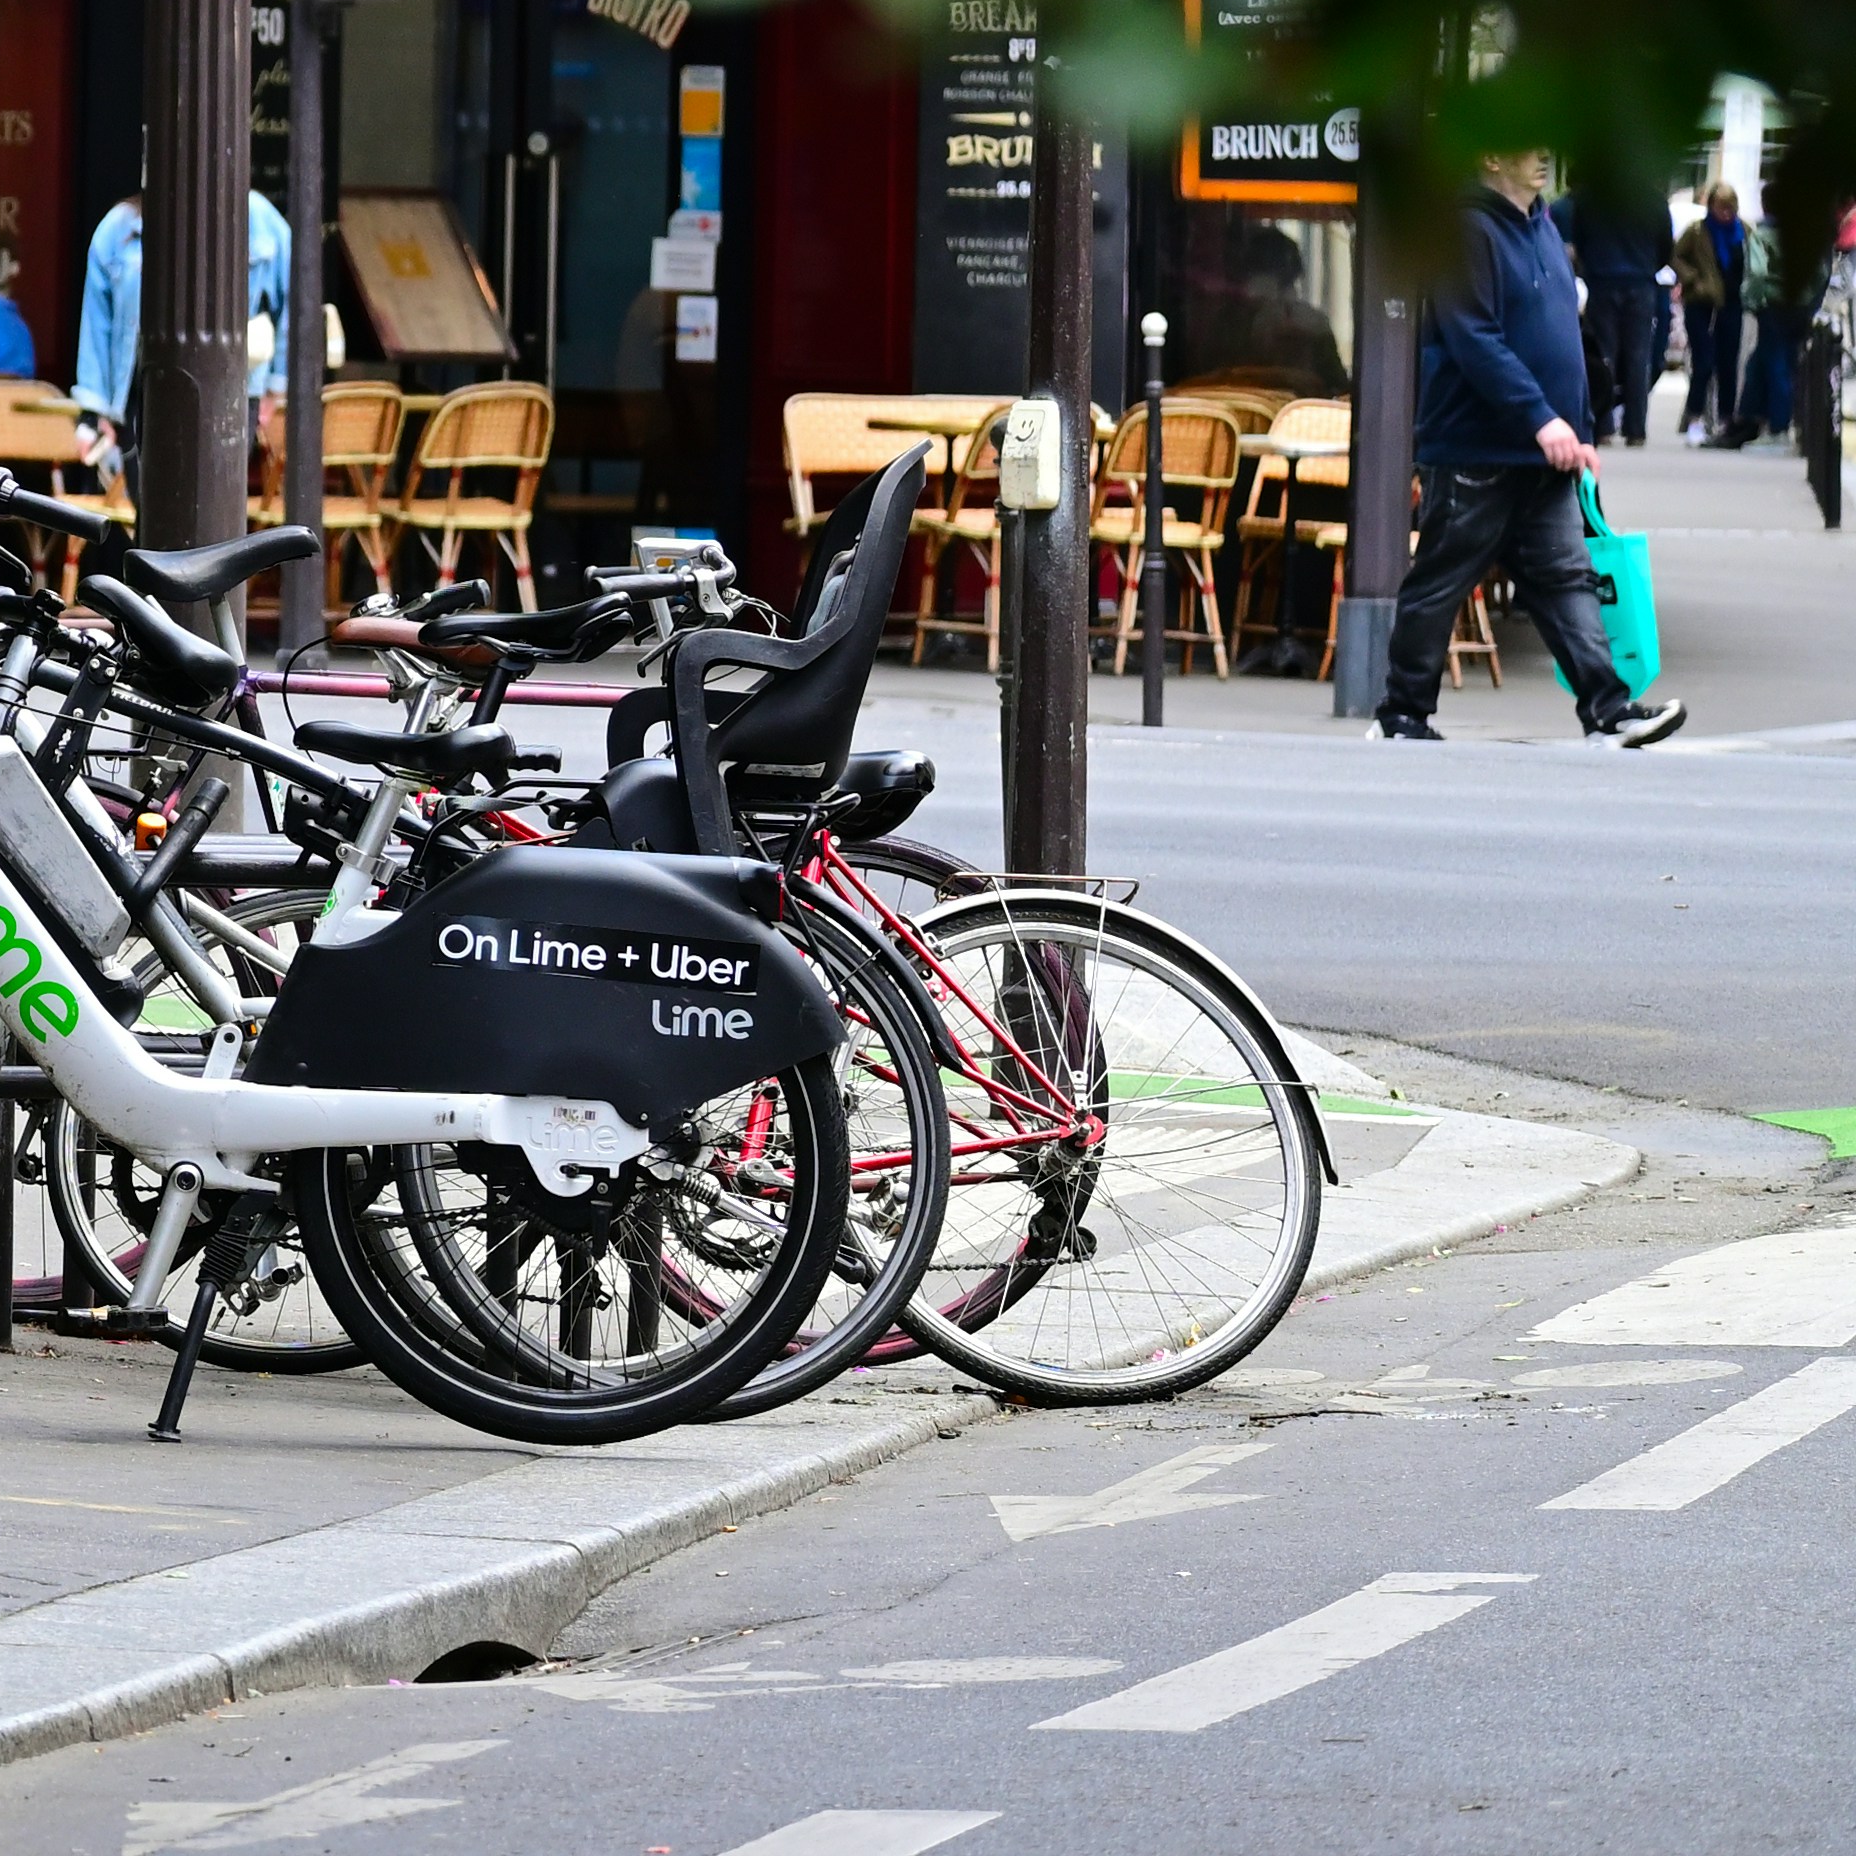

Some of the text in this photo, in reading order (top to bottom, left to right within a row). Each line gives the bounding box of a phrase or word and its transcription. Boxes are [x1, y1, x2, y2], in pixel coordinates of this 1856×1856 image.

[1212, 119, 1360, 161] BRUNCH 25.5
[439, 924, 499, 962] On
[508, 929, 607, 971] Lime
[650, 942, 750, 986] Uber
[651, 998, 754, 1040] Lime
